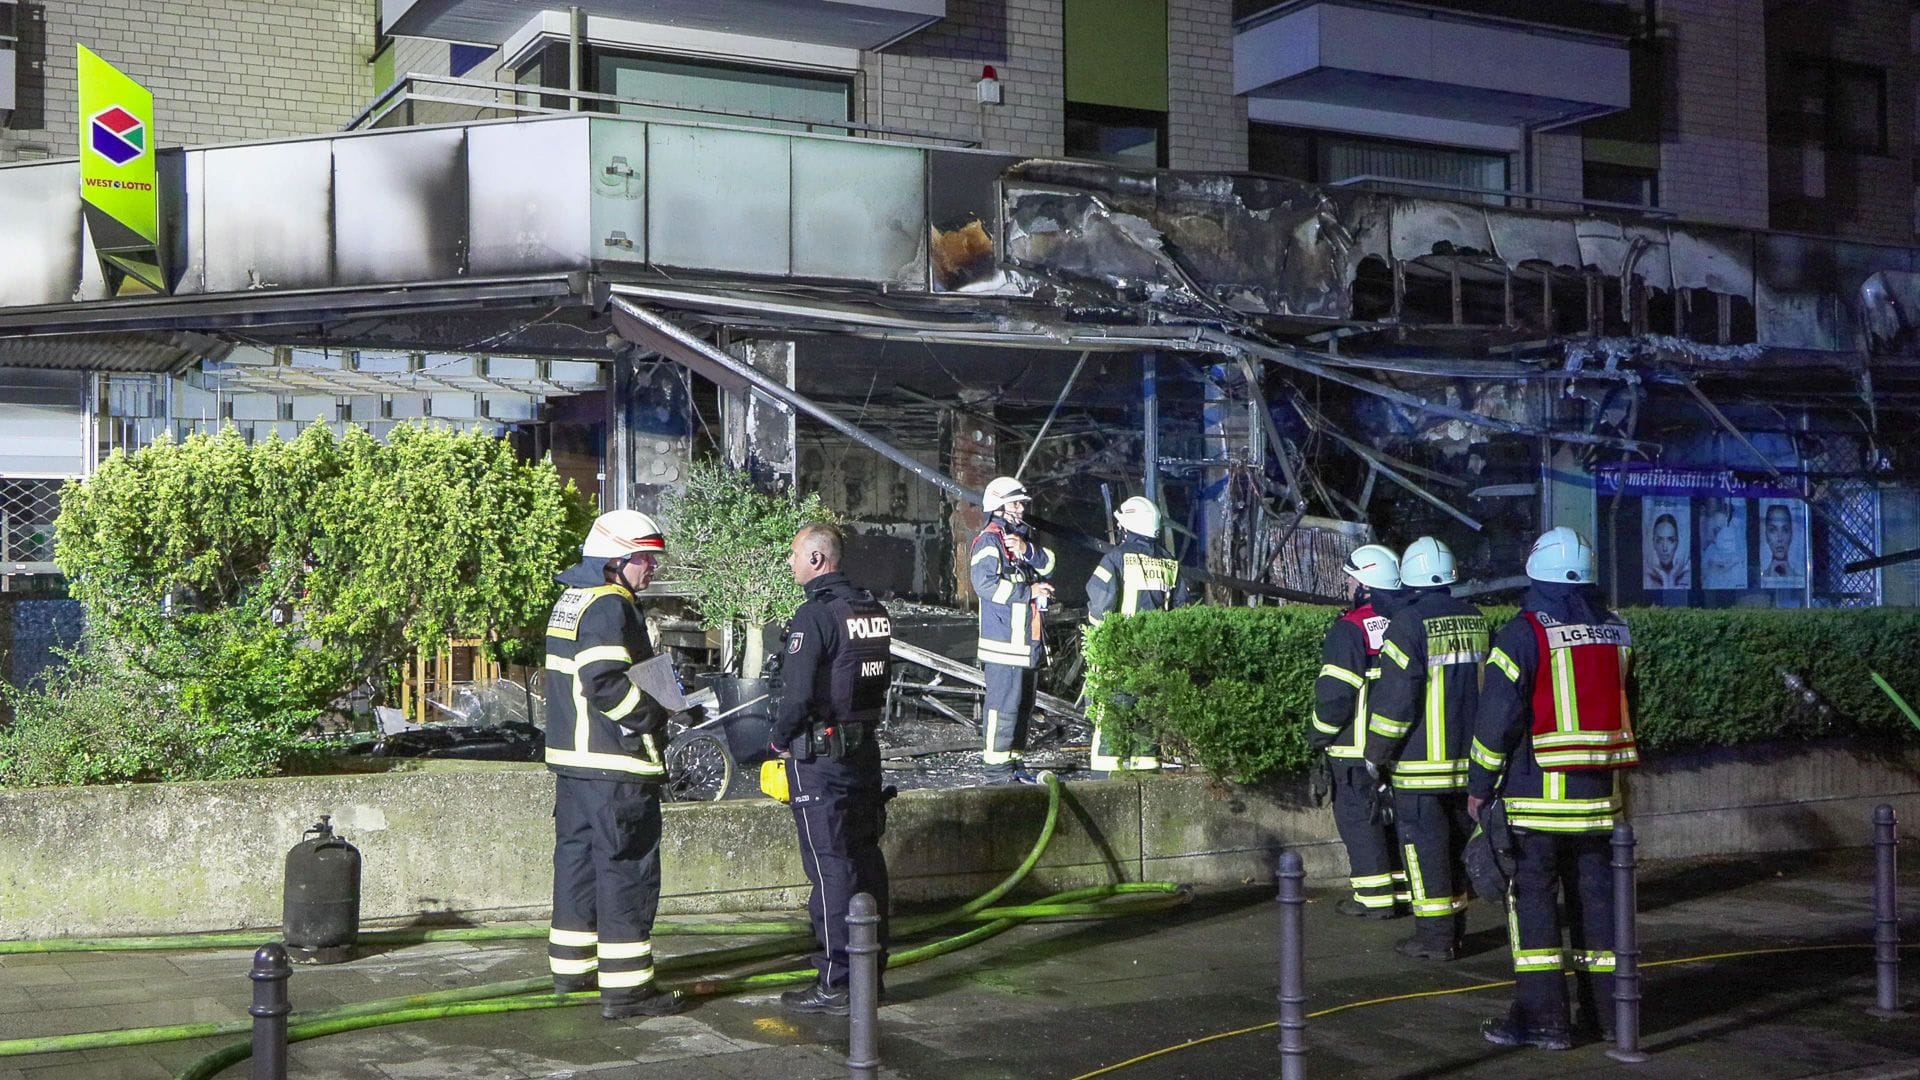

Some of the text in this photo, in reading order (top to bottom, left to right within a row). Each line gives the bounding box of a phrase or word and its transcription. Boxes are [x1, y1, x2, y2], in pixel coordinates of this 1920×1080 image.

[86, 178, 152, 191] WEST LOTTO
[1600, 468, 1716, 490] Kometikinstitut
[1561, 628, 1620, 642] LG-ESCH
[861, 661, 885, 677] NRW
